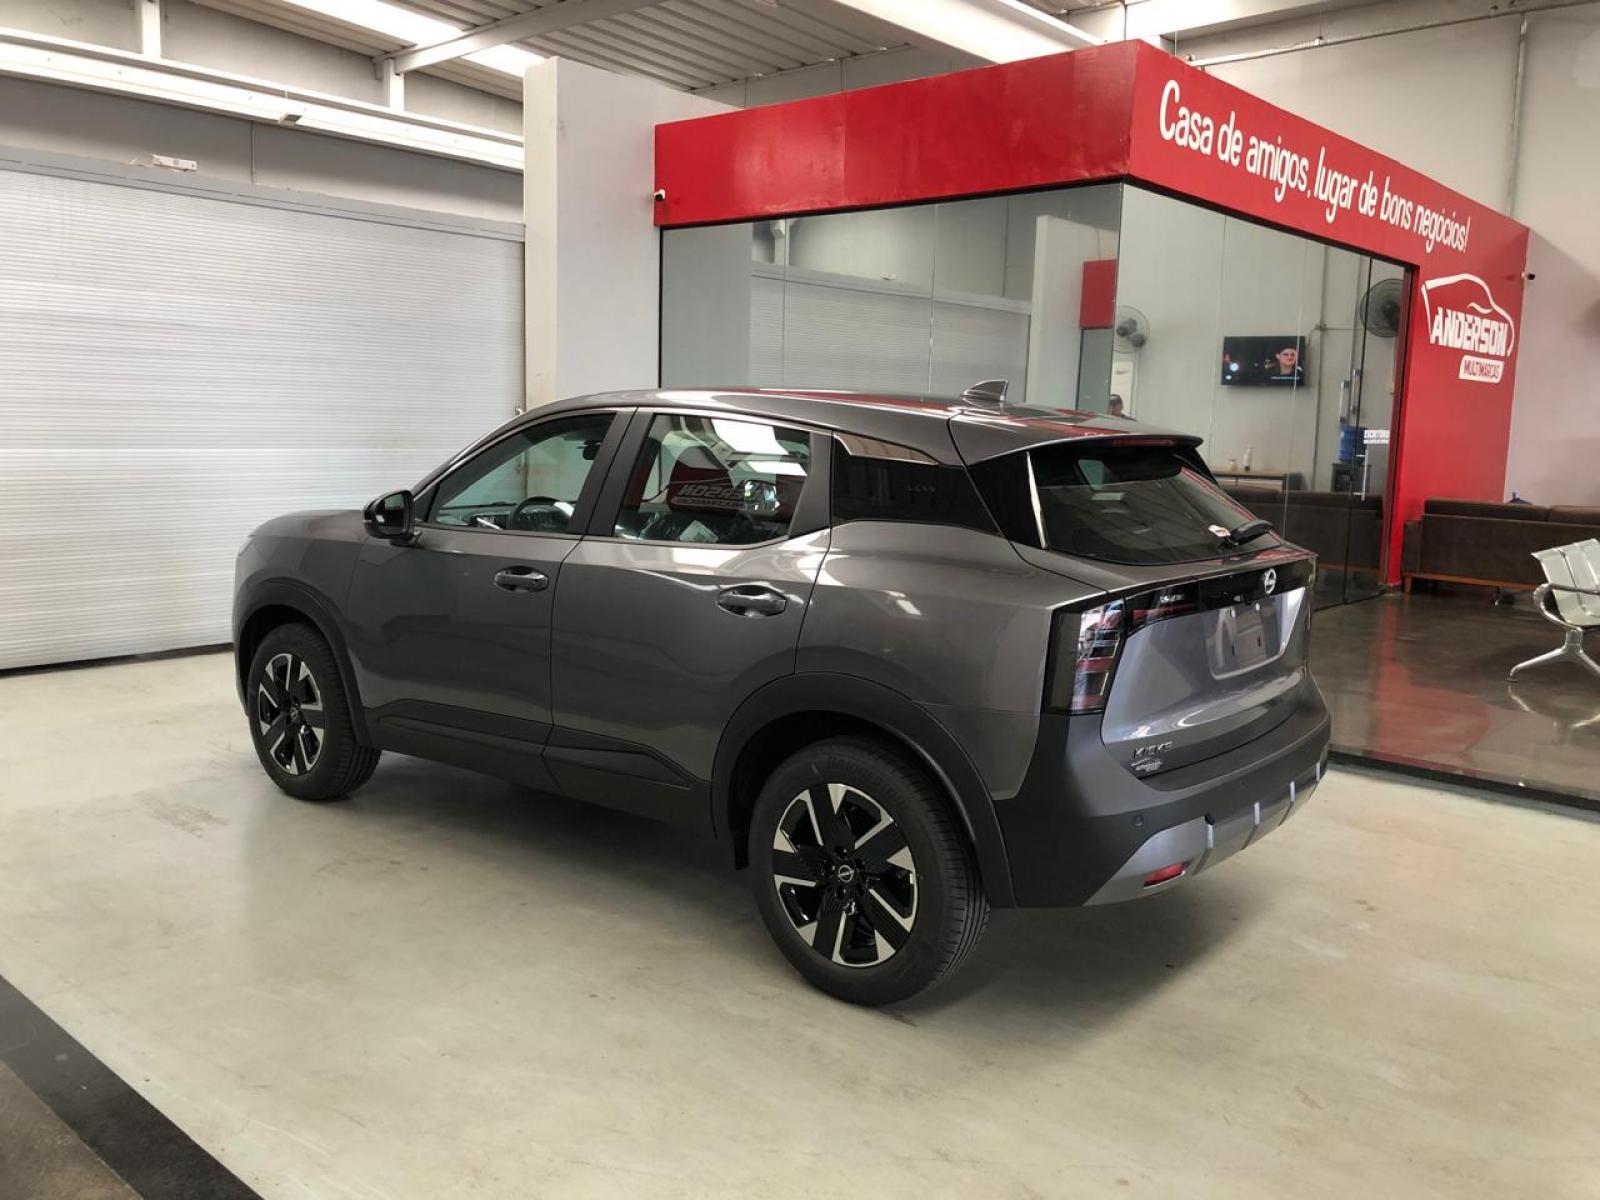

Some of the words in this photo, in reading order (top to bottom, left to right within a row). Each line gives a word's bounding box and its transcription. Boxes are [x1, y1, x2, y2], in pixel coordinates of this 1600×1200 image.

[1159, 79, 1215, 156] Casa
[1217, 110, 1243, 167] de
[1246, 136, 1311, 203] amigos,
[1314, 146, 1358, 224] lugar
[1358, 171, 1378, 217] de
[1379, 176, 1414, 230] bons
[1413, 209, 1471, 253] negócios!
[1429, 306, 1509, 357] ANDERSON
